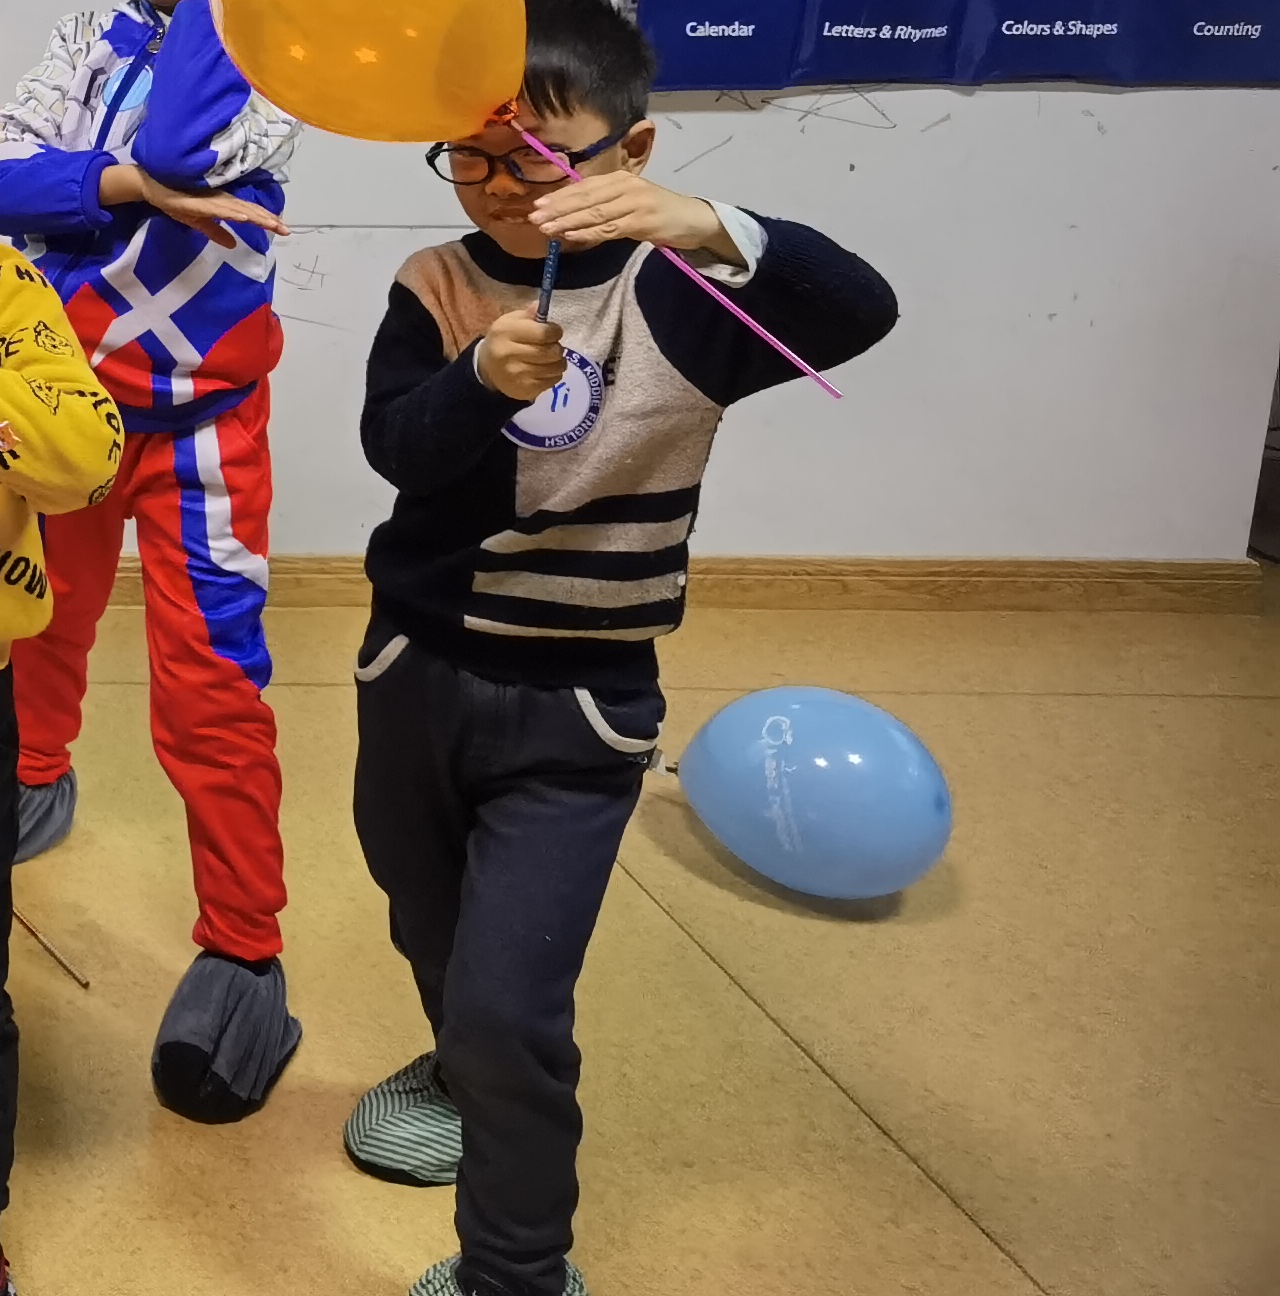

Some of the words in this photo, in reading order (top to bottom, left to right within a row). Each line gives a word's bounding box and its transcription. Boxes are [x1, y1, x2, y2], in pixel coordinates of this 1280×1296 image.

[685, 21, 755, 37] Calendar
[823, 22, 876, 38] Letters
[879, 24, 892, 39] &
[894, 24, 948, 43] Rhymes
[1001, 20, 1051, 36] Colors
[1053, 21, 1065, 36] &
[1067, 20, 1118, 39] Shapes
[1193, 21, 1261, 39] Counting
[583, 365, 602, 407] KIDDIE
[545, 412, 597, 447] ENGLISH
